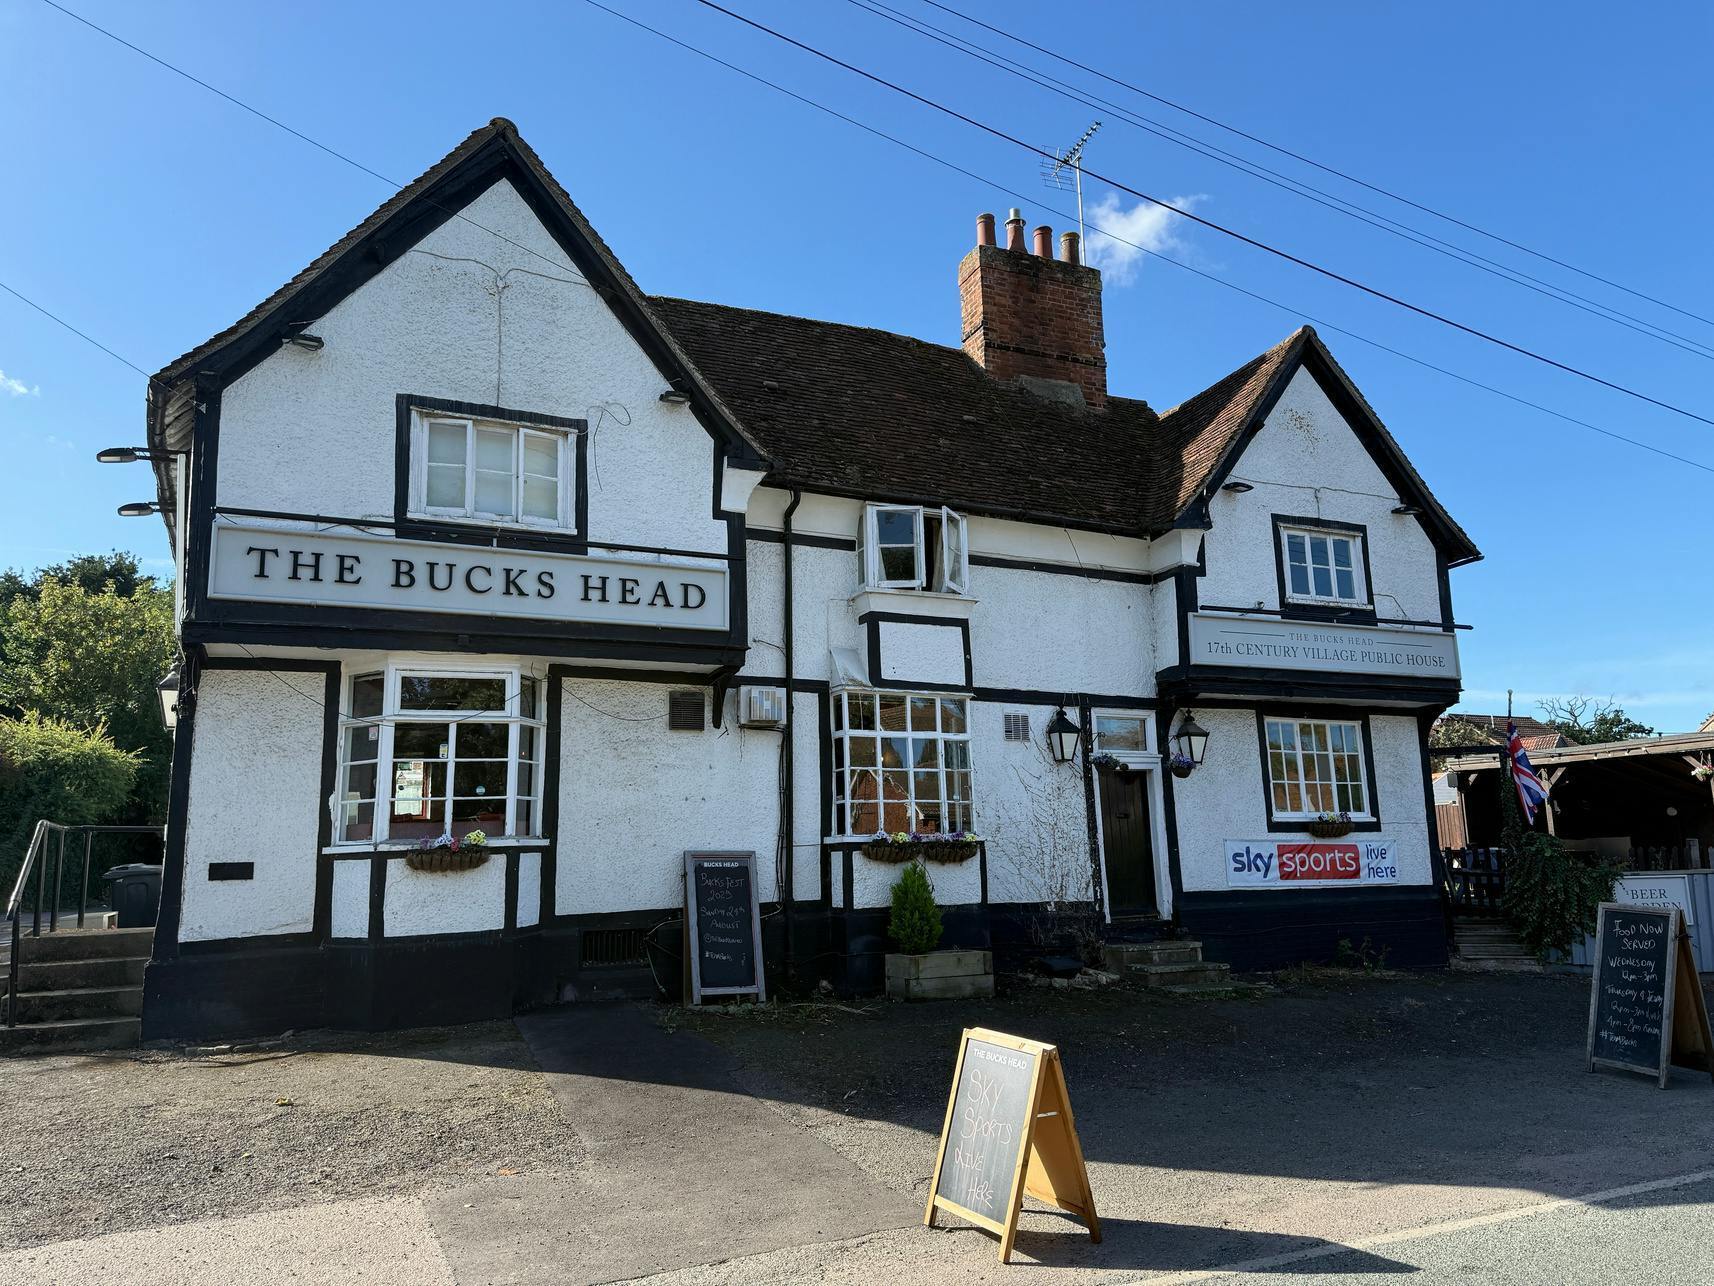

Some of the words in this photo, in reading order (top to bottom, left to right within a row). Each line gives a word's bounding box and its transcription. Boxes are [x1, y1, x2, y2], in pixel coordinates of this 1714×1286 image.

[247, 547, 362, 584] THE
[391, 559, 555, 599] BUCKS
[580, 574, 706, 609] HEAD
[1289, 632, 1310, 642] THE
[1314, 634, 1344, 644] BUCKS
[1348, 637, 1374, 647] HEAD
[1207, 642, 1232, 654] 17th
[1236, 643, 1299, 658] CENTURY
[1303, 647, 1358, 662] VILLAGE
[1360, 650, 1403, 665] PUBLIC
[1406, 653, 1446, 668] HOUSE
[1365, 844, 1387, 860] live
[1231, 846, 1274, 879] sky
[1282, 850, 1357, 877] sports
[1367, 863, 1397, 879] here
[1631, 889, 1668, 900] BEER
[1621, 938, 1656, 951] SERVED
[973, 1047, 985, 1057] THE
[986, 1051, 1008, 1065] BUCKS
[1008, 1056, 1027, 1070] HEAD
